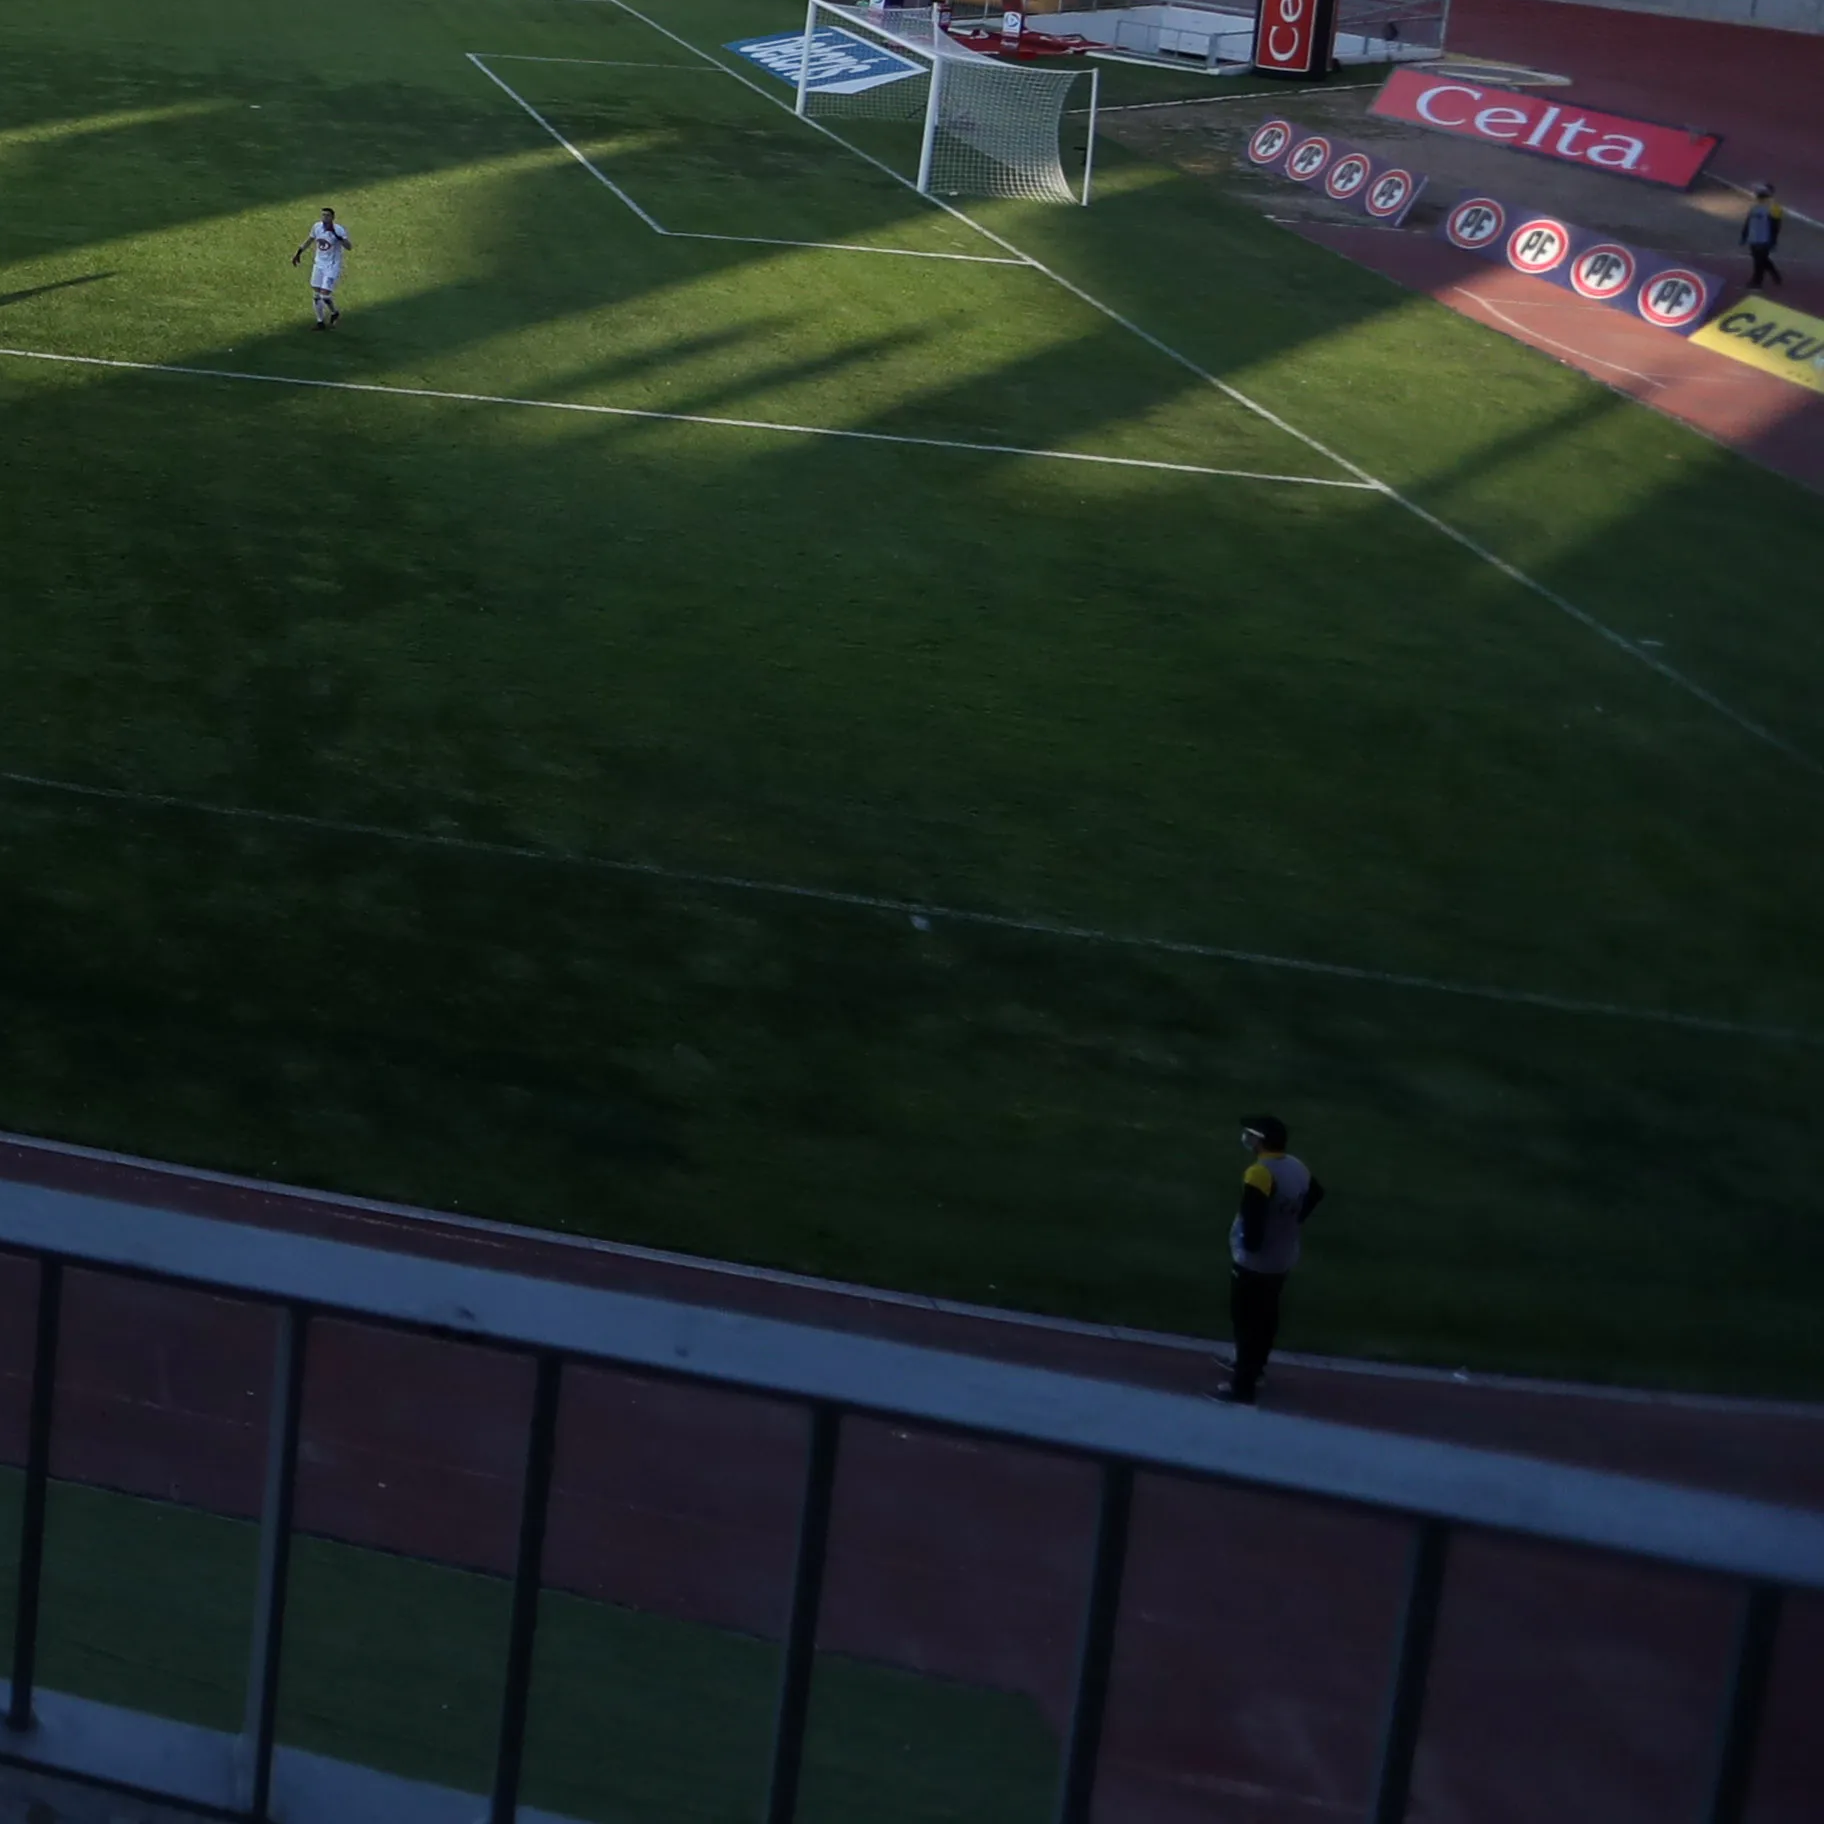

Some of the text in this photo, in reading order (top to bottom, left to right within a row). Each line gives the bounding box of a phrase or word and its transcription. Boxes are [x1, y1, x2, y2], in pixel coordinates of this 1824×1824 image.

[1256, 129, 1283, 155] PF
[1415, 85, 1647, 171] Celta
[1294, 145, 1322, 171] PF
[1334, 162, 1361, 189] PF
[1374, 179, 1403, 207] PF
[1457, 207, 1493, 239] PF
[1519, 229, 1556, 262] PF
[1584, 253, 1622, 288] PF
[1652, 279, 1693, 315] PF
[1718, 312, 1824, 362] CAFU
